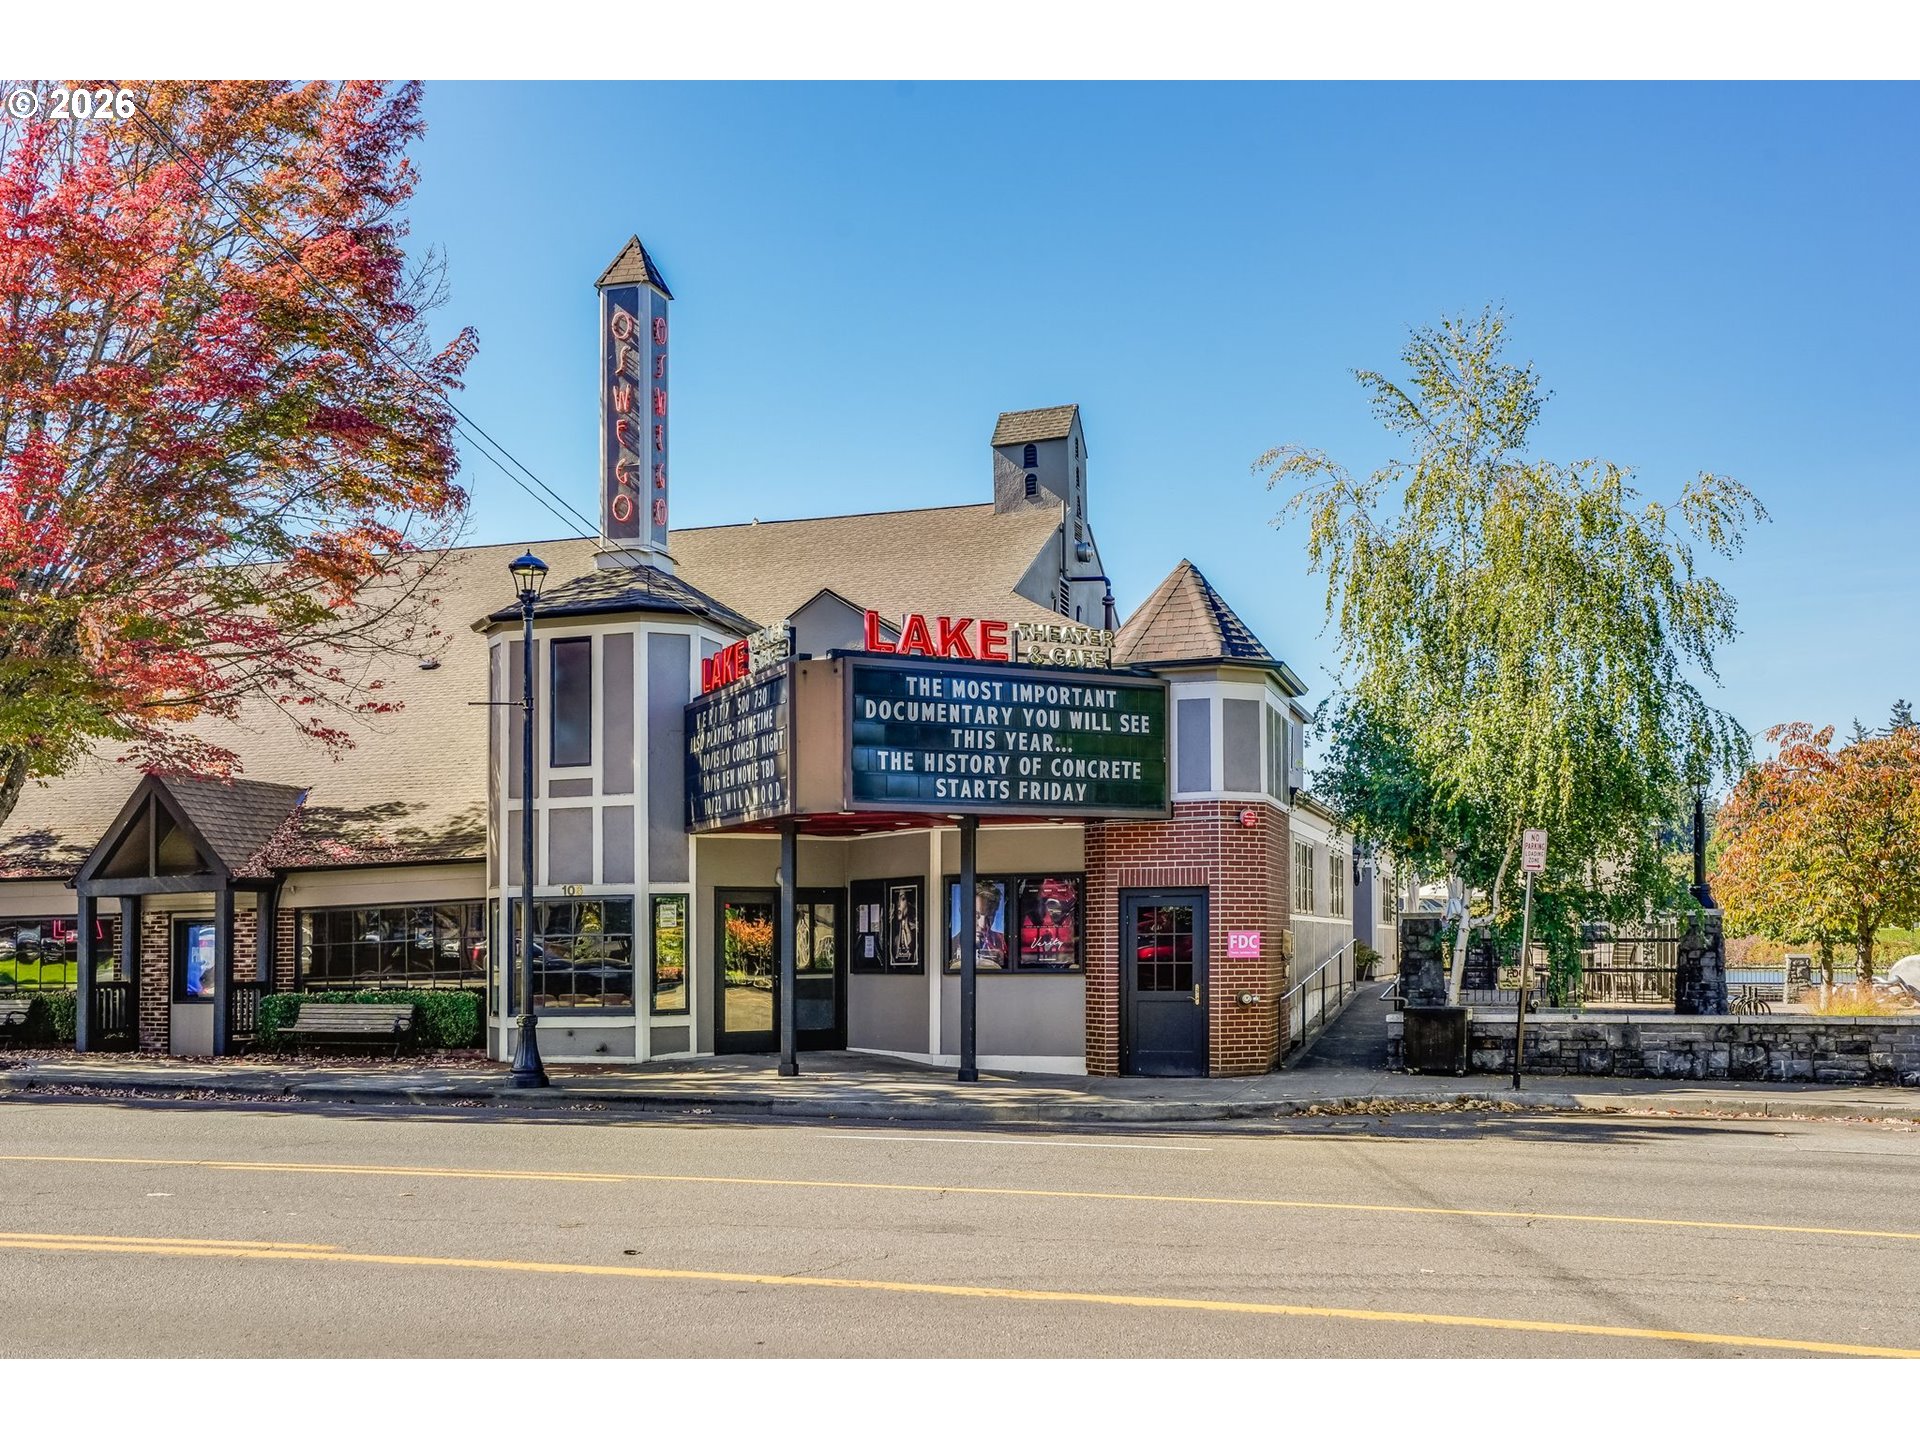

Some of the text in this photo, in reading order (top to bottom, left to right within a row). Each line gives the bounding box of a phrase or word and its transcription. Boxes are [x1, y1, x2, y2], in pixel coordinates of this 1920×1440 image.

[612, 311, 633, 523] OSWEGO
[865, 610, 1008, 662] LAKE
[1014, 622, 1116, 648] THEATER
[702, 639, 748, 694] LAKE
[1027, 645, 1110, 669] & CAFE
[737, 694, 749, 715] 500
[754, 687, 767, 709] 730
[906, 676, 1117, 708] THE MOST IMPORTANT
[865, 699, 1150, 733] DOCUMENTARY YOU WILL SEE
[689, 709, 773, 754] ALSO PLAYING: PRIMETIME
[951, 729, 1073, 753] THIS YEAR...
[703, 731, 784, 771] 10/15 LO COMEDY NIGHT
[878, 751, 1141, 780] THE HISTORY OF CONCRETE
[723, 769, 735, 788] NEW
[737, 763, 758, 784] MOVIE
[761, 759, 775, 778] TBD
[704, 782, 781, 815] 10/22 WILDWOOD
[936, 778, 1087, 802] STARTS FRIDAY
[1525, 842, 1545, 850] PARKING
[1531, 834, 1540, 842] NO
[1030, 936, 1064, 950] Verity
[1230, 934, 1258, 949] FDC
